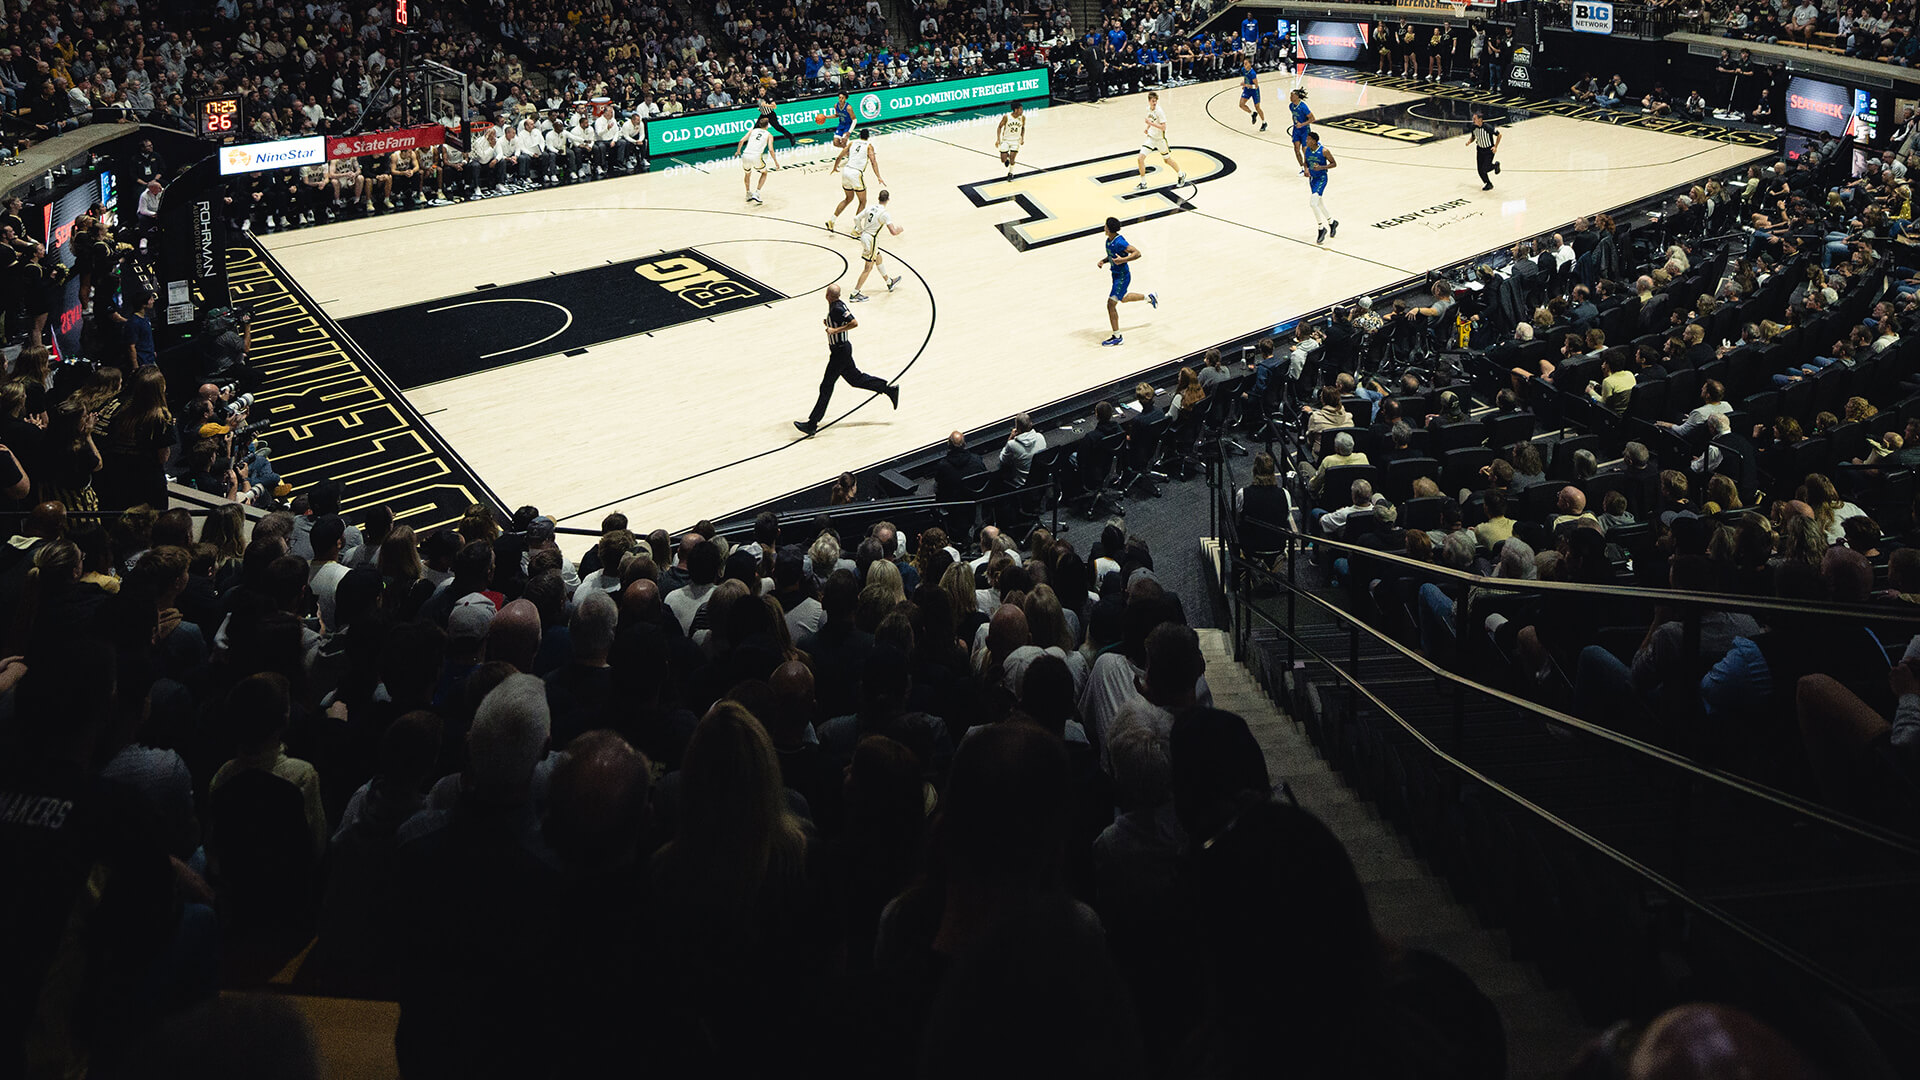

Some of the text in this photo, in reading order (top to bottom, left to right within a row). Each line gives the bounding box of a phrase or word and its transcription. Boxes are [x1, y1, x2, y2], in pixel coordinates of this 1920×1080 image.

[396, 0, 407, 25] 26
[1576, 20, 1609, 29] NETWORK
[1508, 79, 1531, 89] PIONEER
[890, 79, 1039, 110] OLD DOMINION FREIGHT LINE
[206, 100, 237, 114] 17:25
[1790, 94, 1844, 120] SEATGEEK
[1870, 98, 1877, 108] 2
[208, 114, 232, 131] 26
[662, 126, 691, 143] OLD
[774, 110, 820, 126] REIGHT
[755, 133, 762, 141] 2
[255, 148, 315, 164] NineStar
[855, 145, 861, 153] 4
[111, 174, 117, 187] 2
[1370, 211, 1424, 230] KEADY
[1421, 198, 1472, 215] COURT
[192, 204, 203, 278] AUTOMOTIVE GROUP
[197, 200, 217, 277] ROHRMAN
